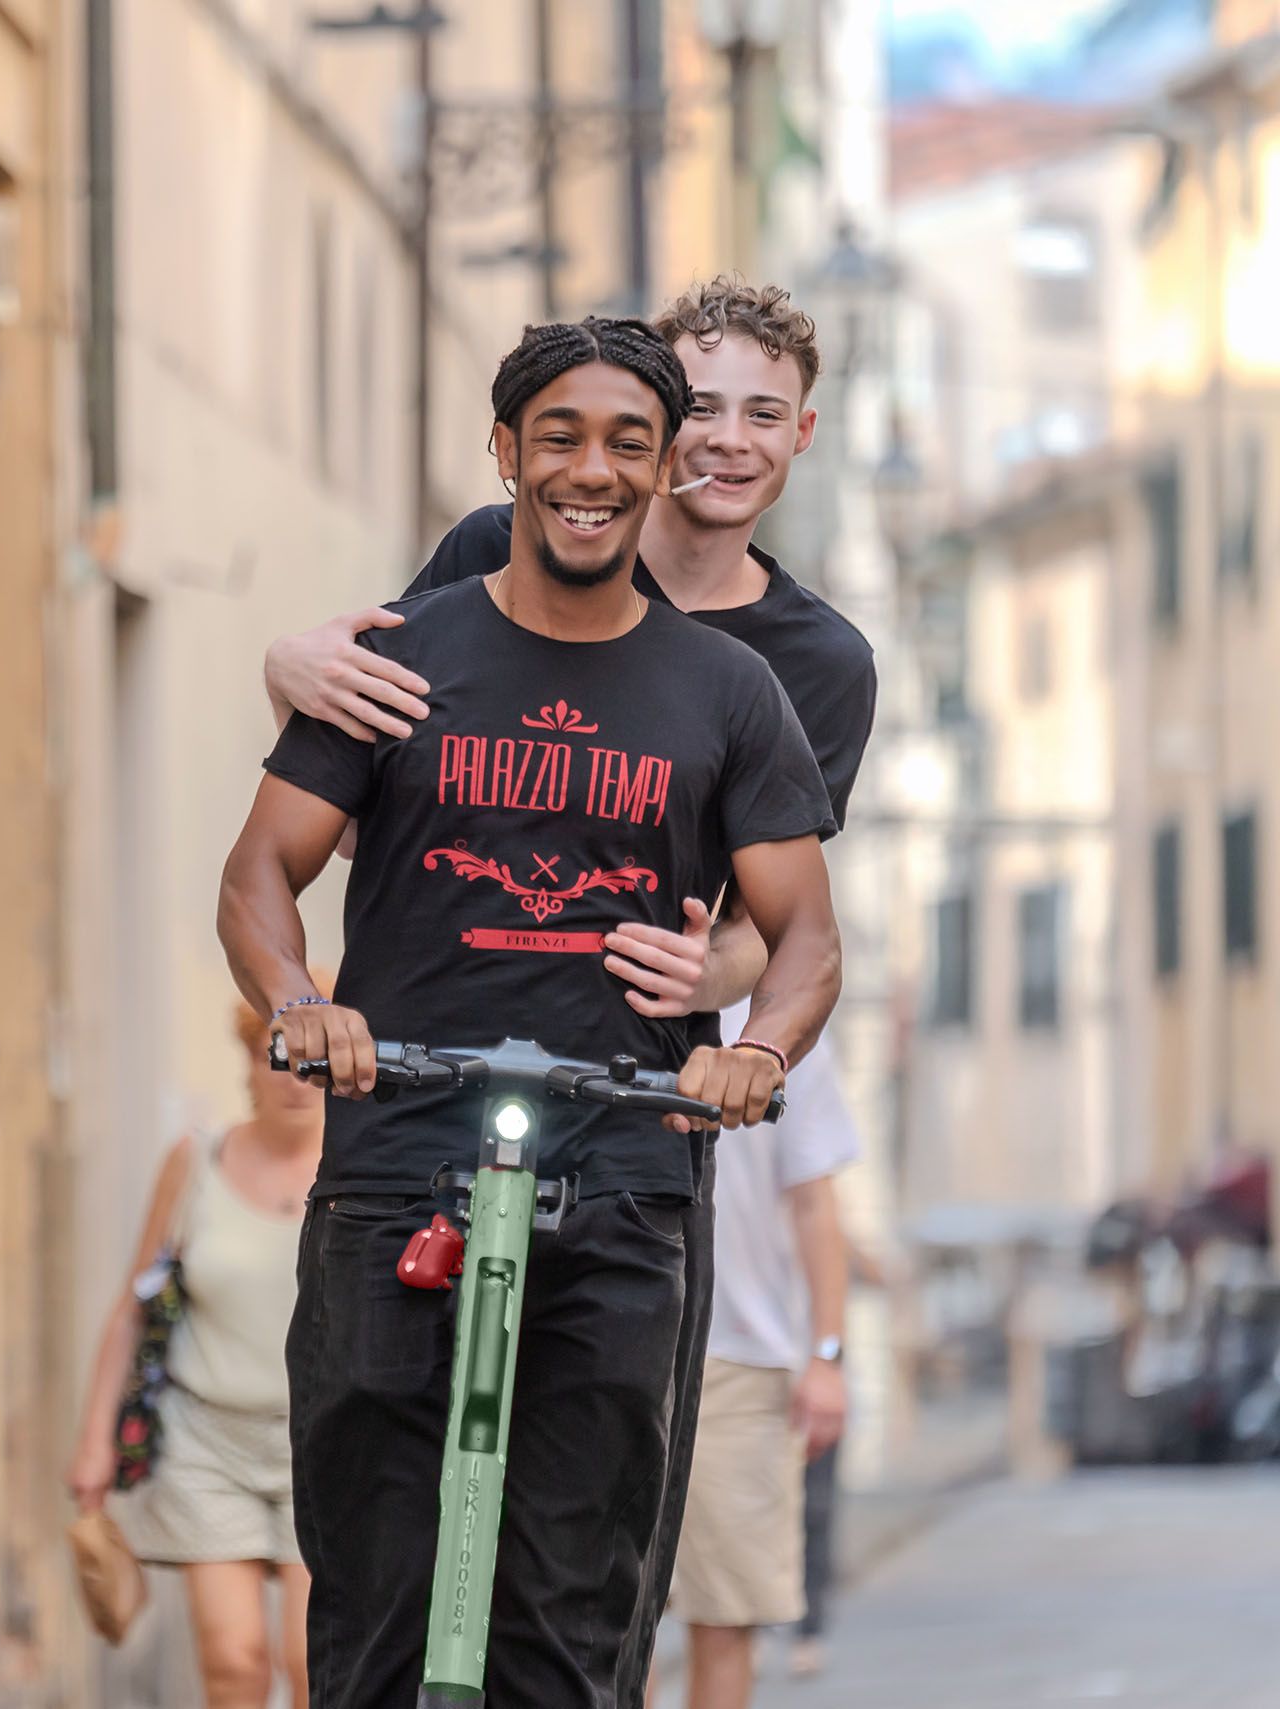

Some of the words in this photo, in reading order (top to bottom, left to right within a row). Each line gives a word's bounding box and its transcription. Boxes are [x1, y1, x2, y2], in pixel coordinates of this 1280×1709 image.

[438, 734, 572, 812] PALAZZO
[586, 747, 672, 827] TEMPI
[505, 935, 569, 948] FIRENZE
